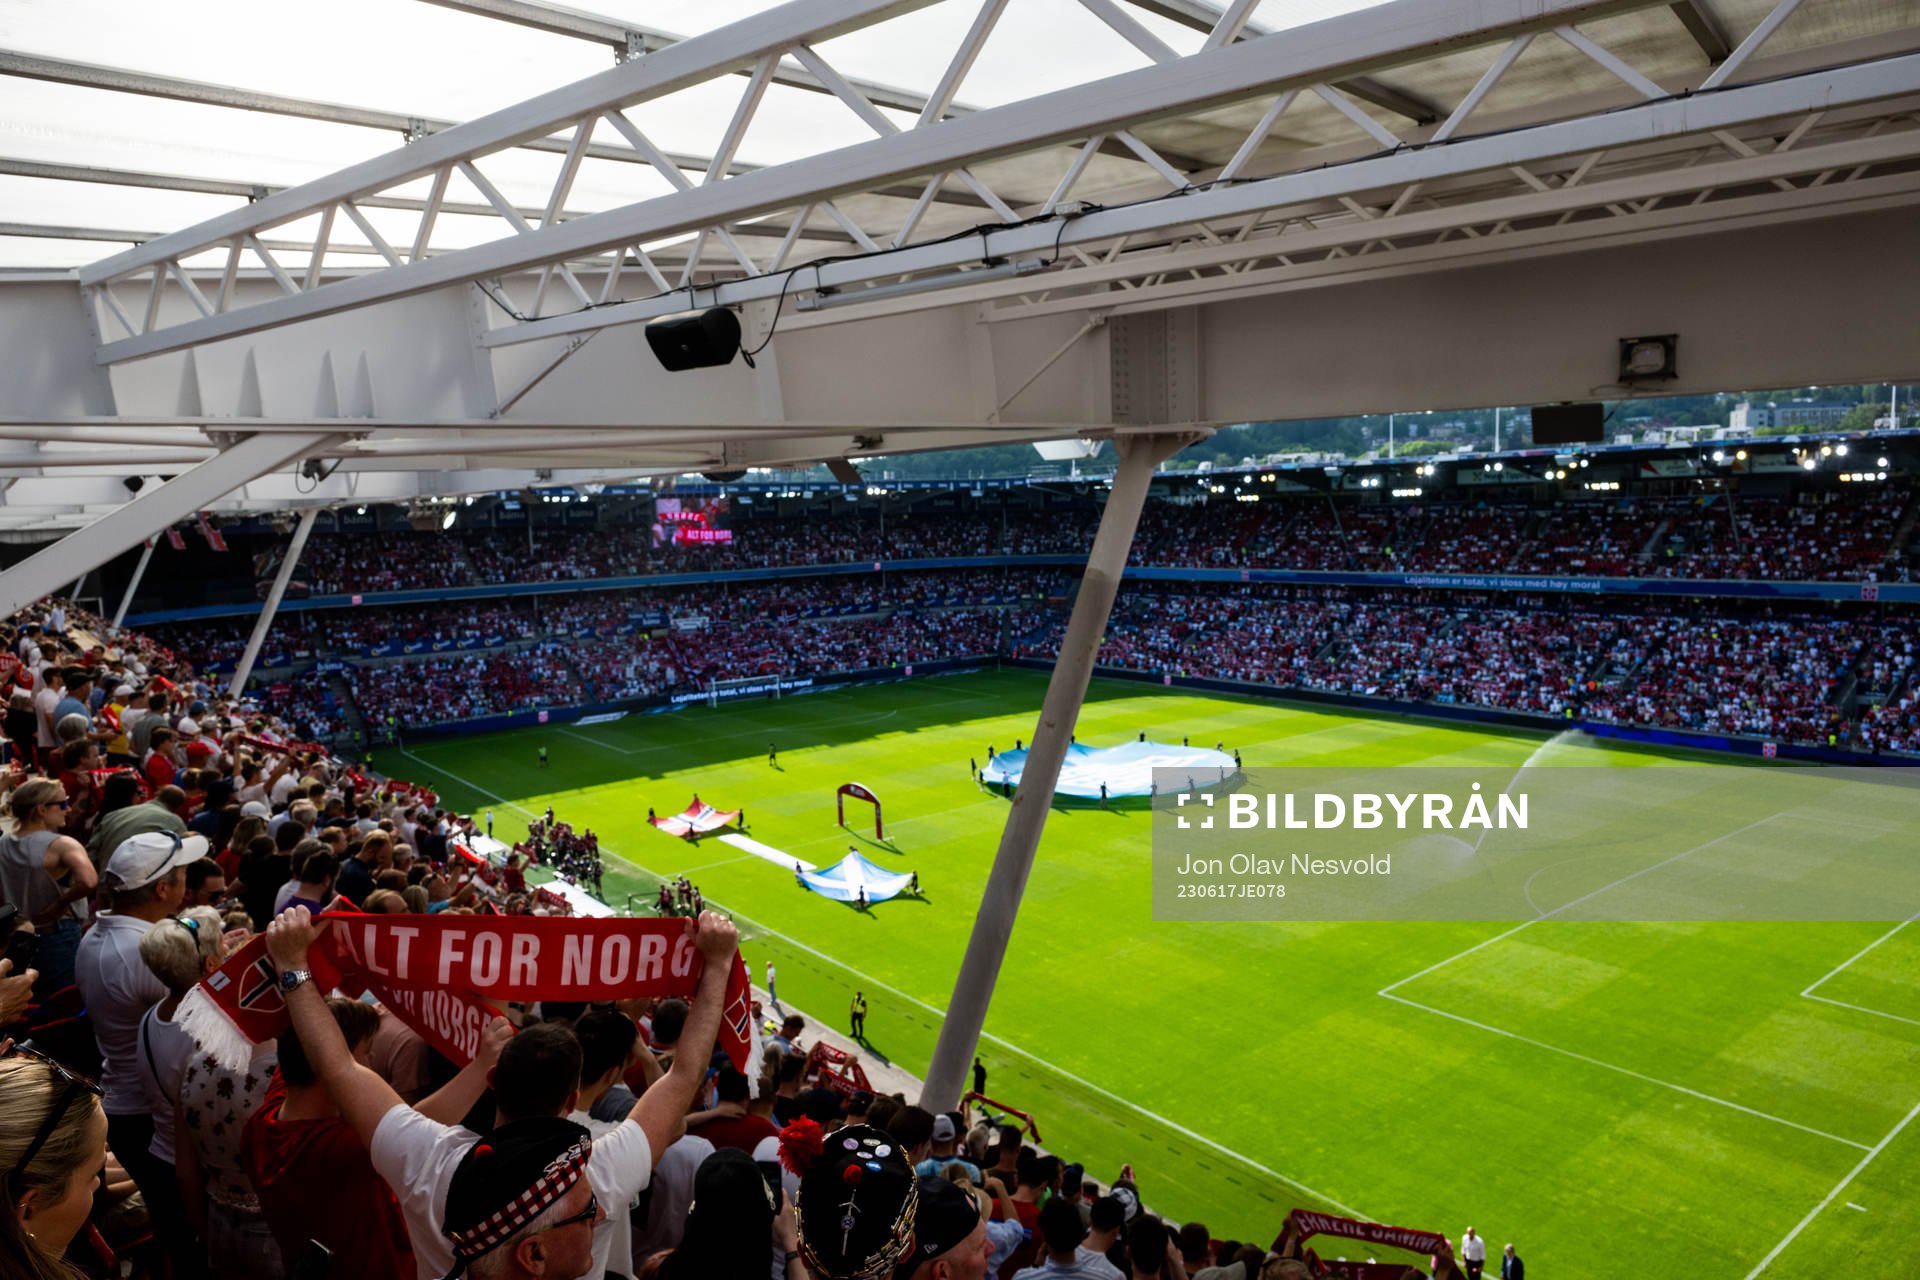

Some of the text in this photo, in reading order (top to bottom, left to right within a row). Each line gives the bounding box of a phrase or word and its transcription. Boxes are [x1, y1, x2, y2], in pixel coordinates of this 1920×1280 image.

[1404, 576, 1450, 587] Lojaliteten
[1451, 577, 1461, 585] er
[1489, 577, 1498, 586] vi
[1500, 577, 1523, 587] sloss
[1525, 578, 1548, 588] med
[1550, 579, 1569, 591] høy
[1571, 580, 1601, 590] moral
[332, 919, 702, 987] ALT FOR NORG
